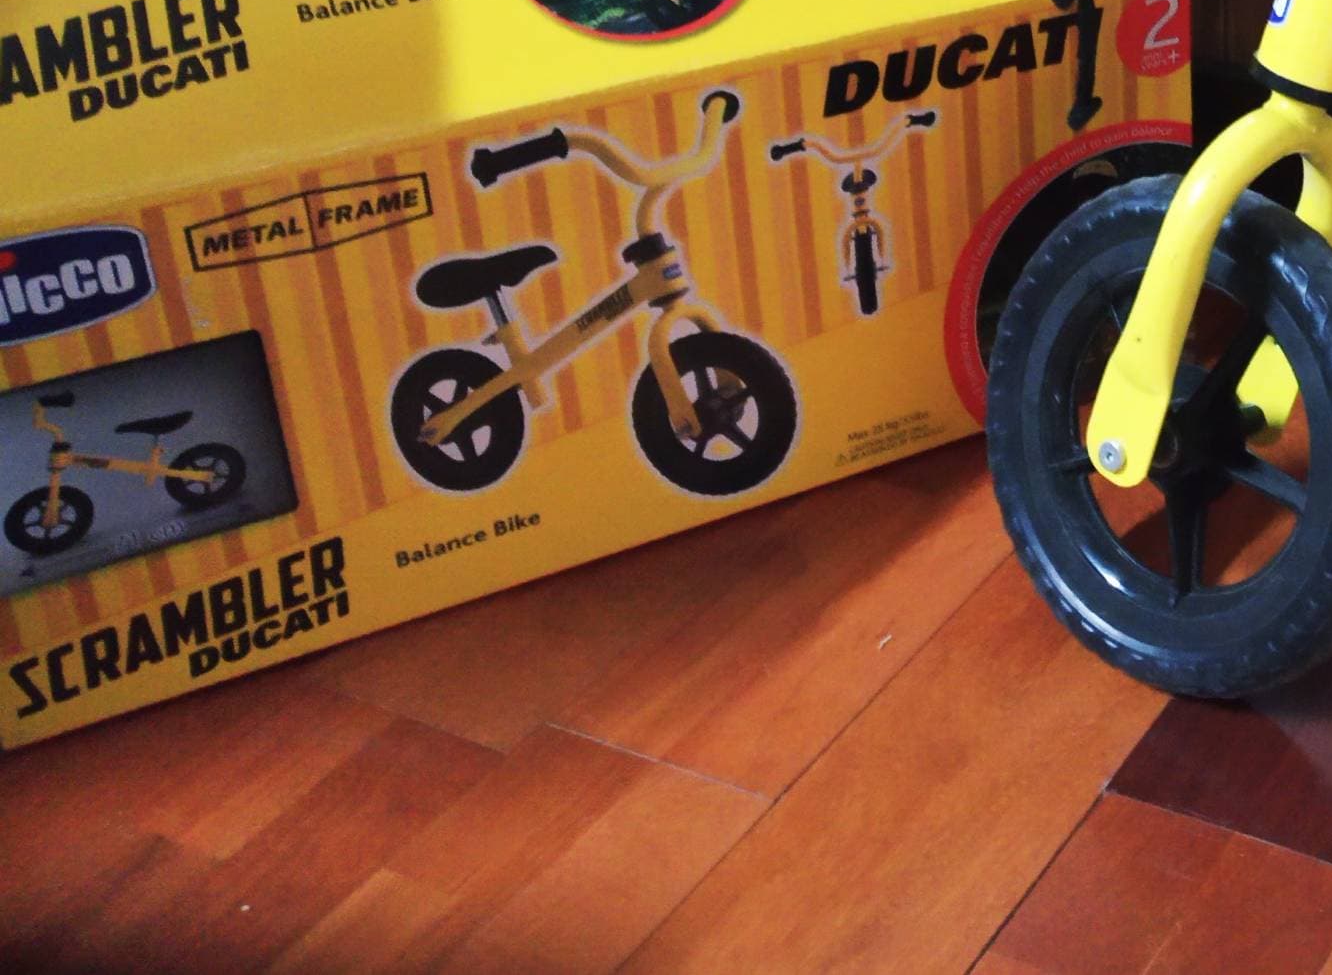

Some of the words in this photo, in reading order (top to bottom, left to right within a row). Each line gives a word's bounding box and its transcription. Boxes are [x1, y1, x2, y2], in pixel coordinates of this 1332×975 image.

[68, 41, 250, 123] DUCATI
[203, 216, 304, 257] METAL
[318, 188, 419, 229] FRAME
[395, 529, 488, 568] Balance
[493, 513, 541, 537] Bike
[9, 535, 346, 720] SCRAMBLER
[188, 591, 350, 677] DUCATI
